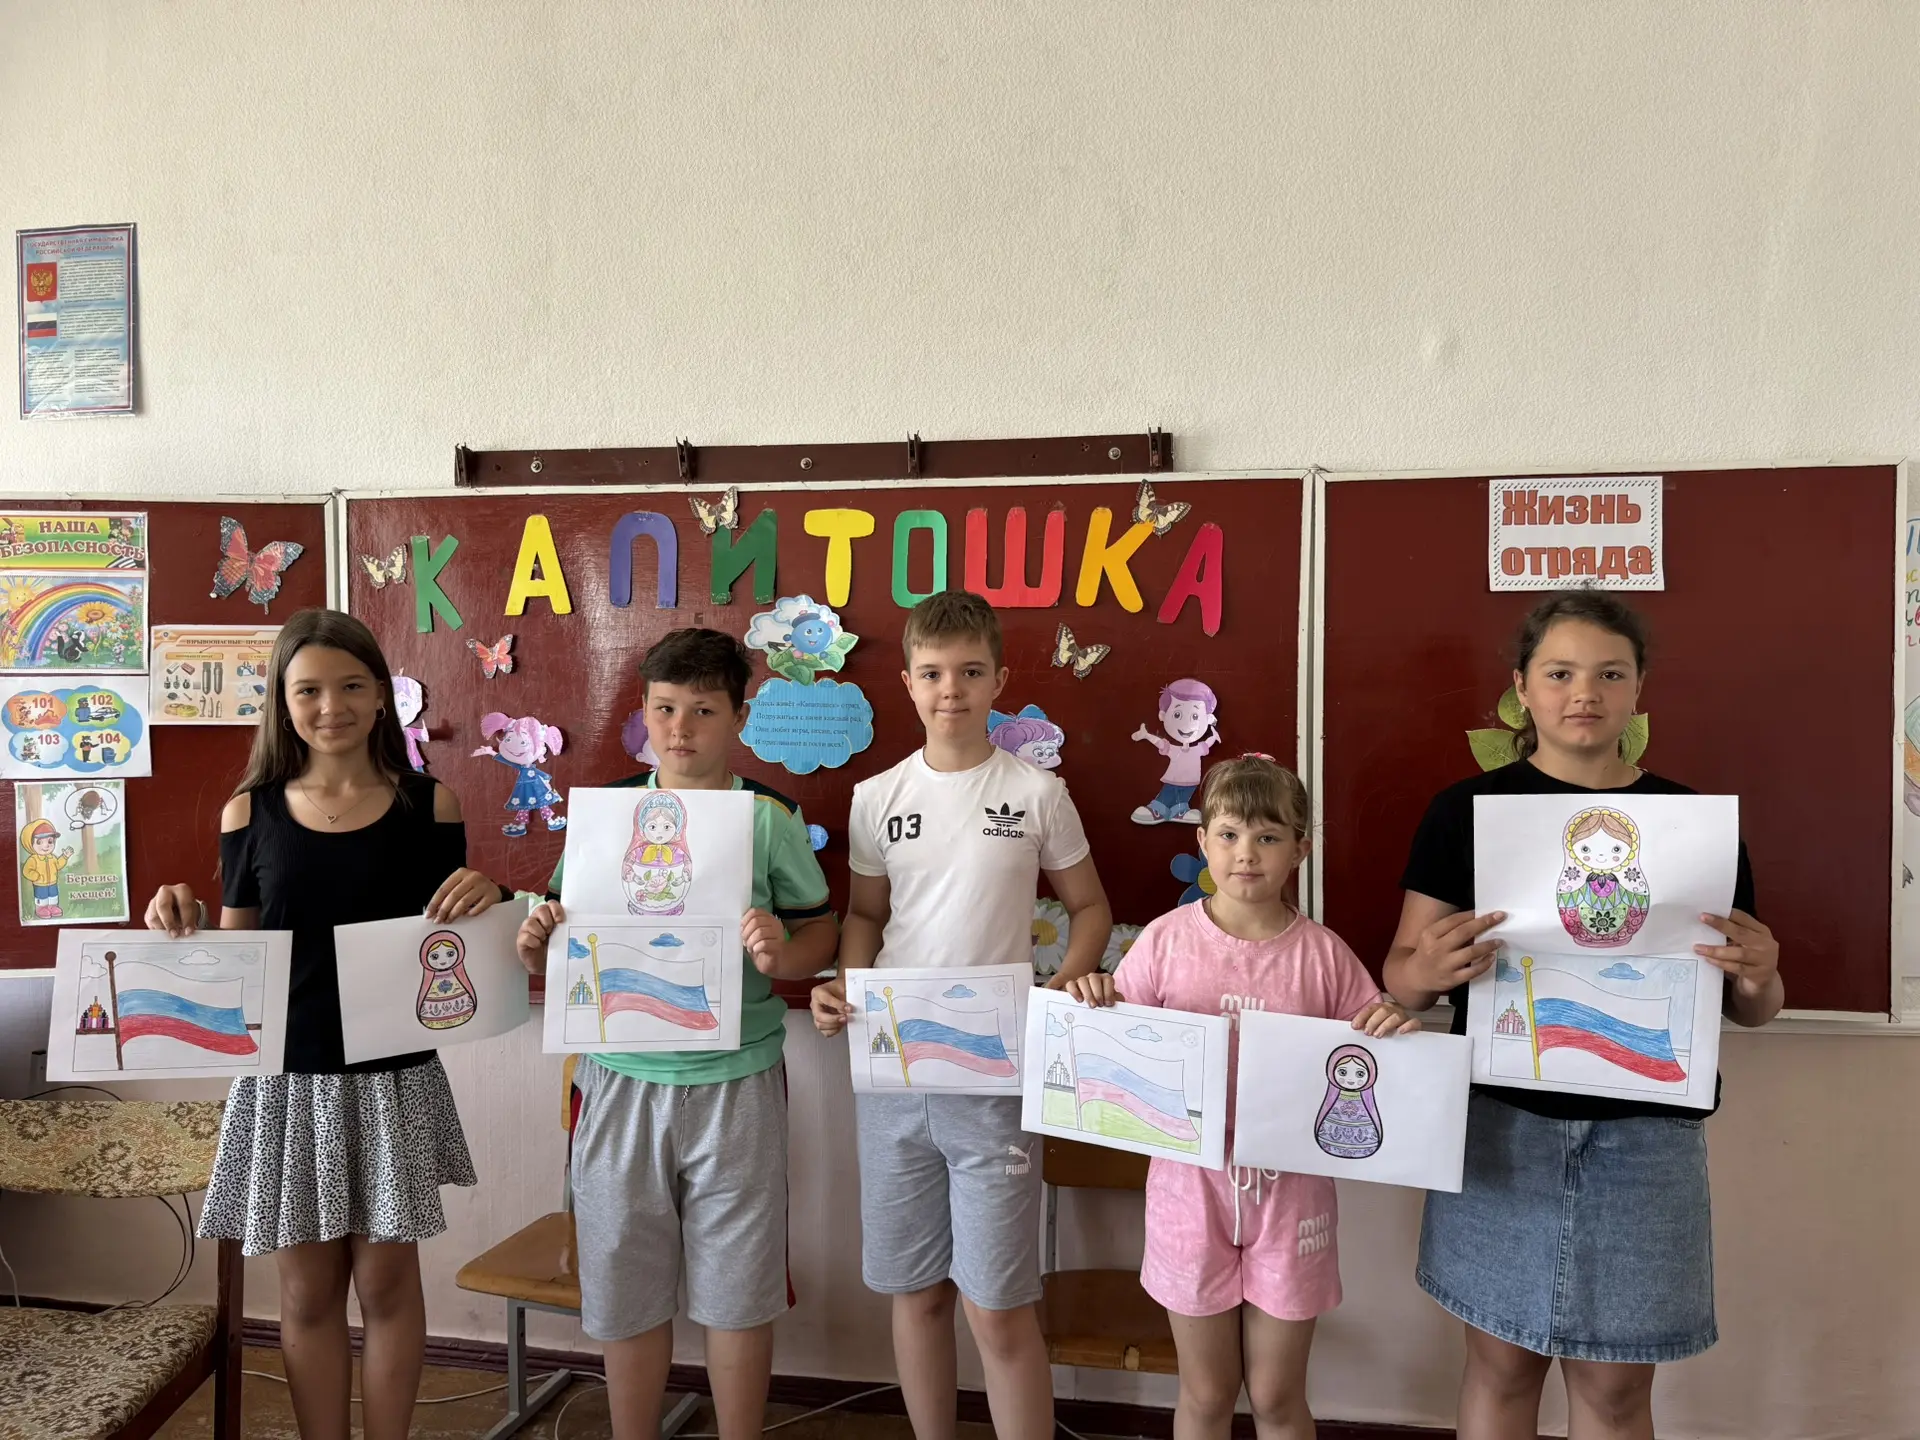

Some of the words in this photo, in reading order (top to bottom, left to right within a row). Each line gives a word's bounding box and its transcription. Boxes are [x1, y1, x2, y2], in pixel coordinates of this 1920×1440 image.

[1502, 490, 1641, 525] Жизнь
[39, 521, 99, 533] НАША
[0, 541, 145, 559] БЕЗОПАСНОСТЬ
[1501, 545, 1653, 579] отряда
[410, 507, 1224, 637] КАПИТОШКА
[32, 698, 54, 708] 101
[91, 695, 113, 705] 102
[38, 734, 60, 745] 103
[98, 733, 121, 744] 104
[888, 813, 922, 843] 03
[983, 827, 1025, 838] adidas
[67, 874, 119, 884] Берегись
[70, 888, 116, 899] клещей!
